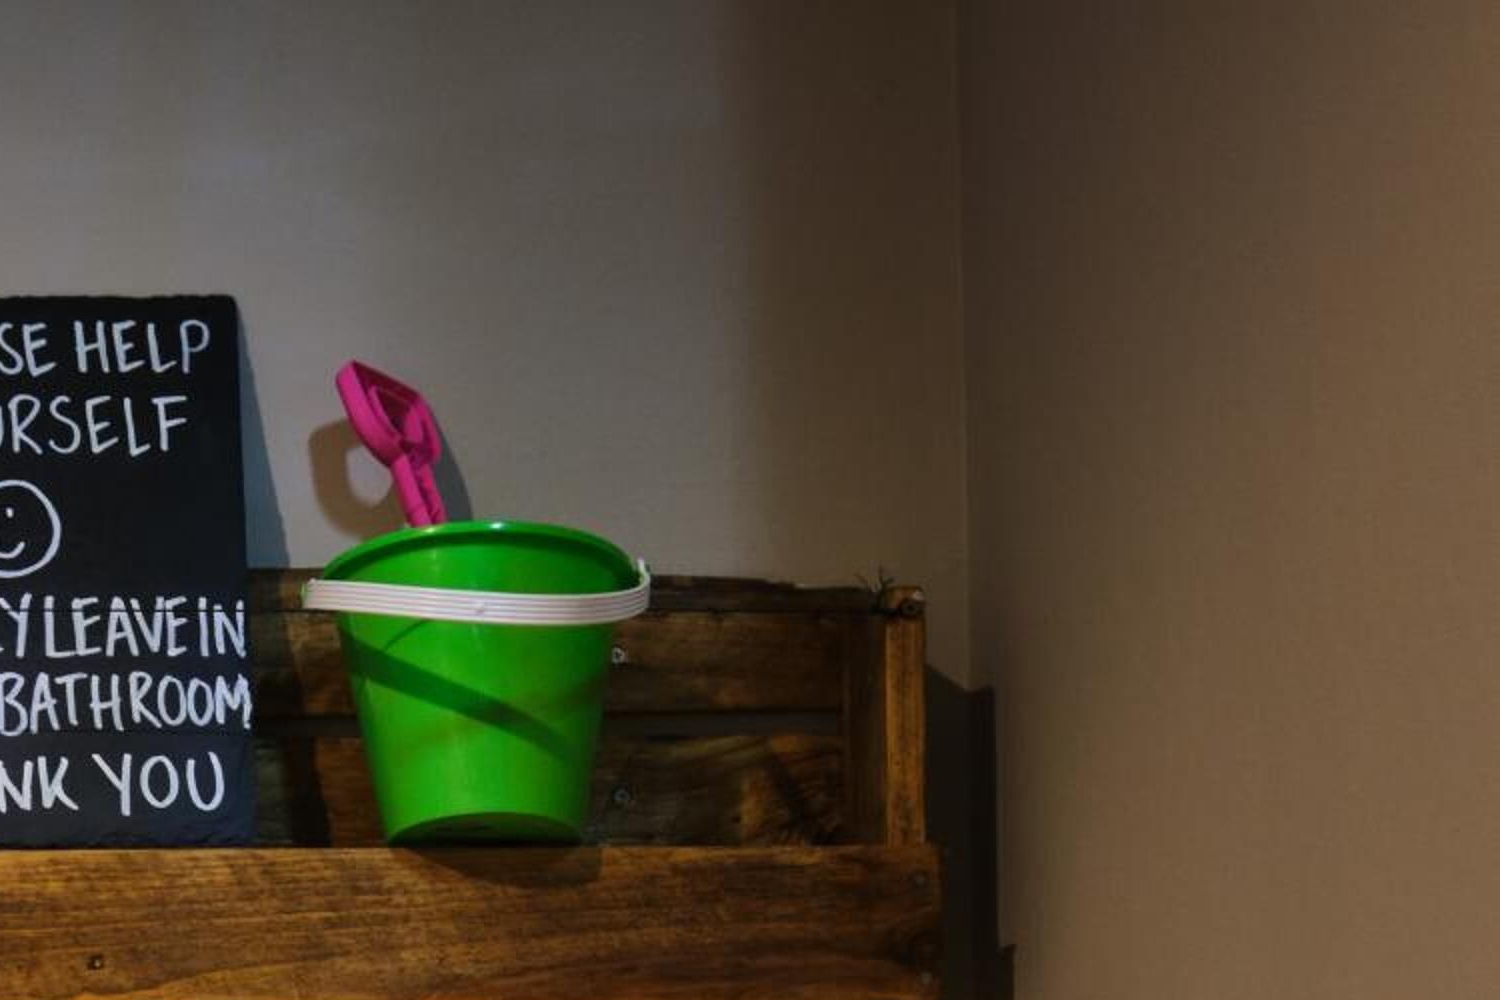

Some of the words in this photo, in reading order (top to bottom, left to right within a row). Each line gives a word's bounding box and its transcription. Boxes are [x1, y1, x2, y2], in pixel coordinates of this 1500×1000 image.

[74, 319, 209, 373] HELP
[43, 595, 188, 659] LEAVE
[197, 596, 247, 658] IN
[91, 751, 225, 817] YOU
